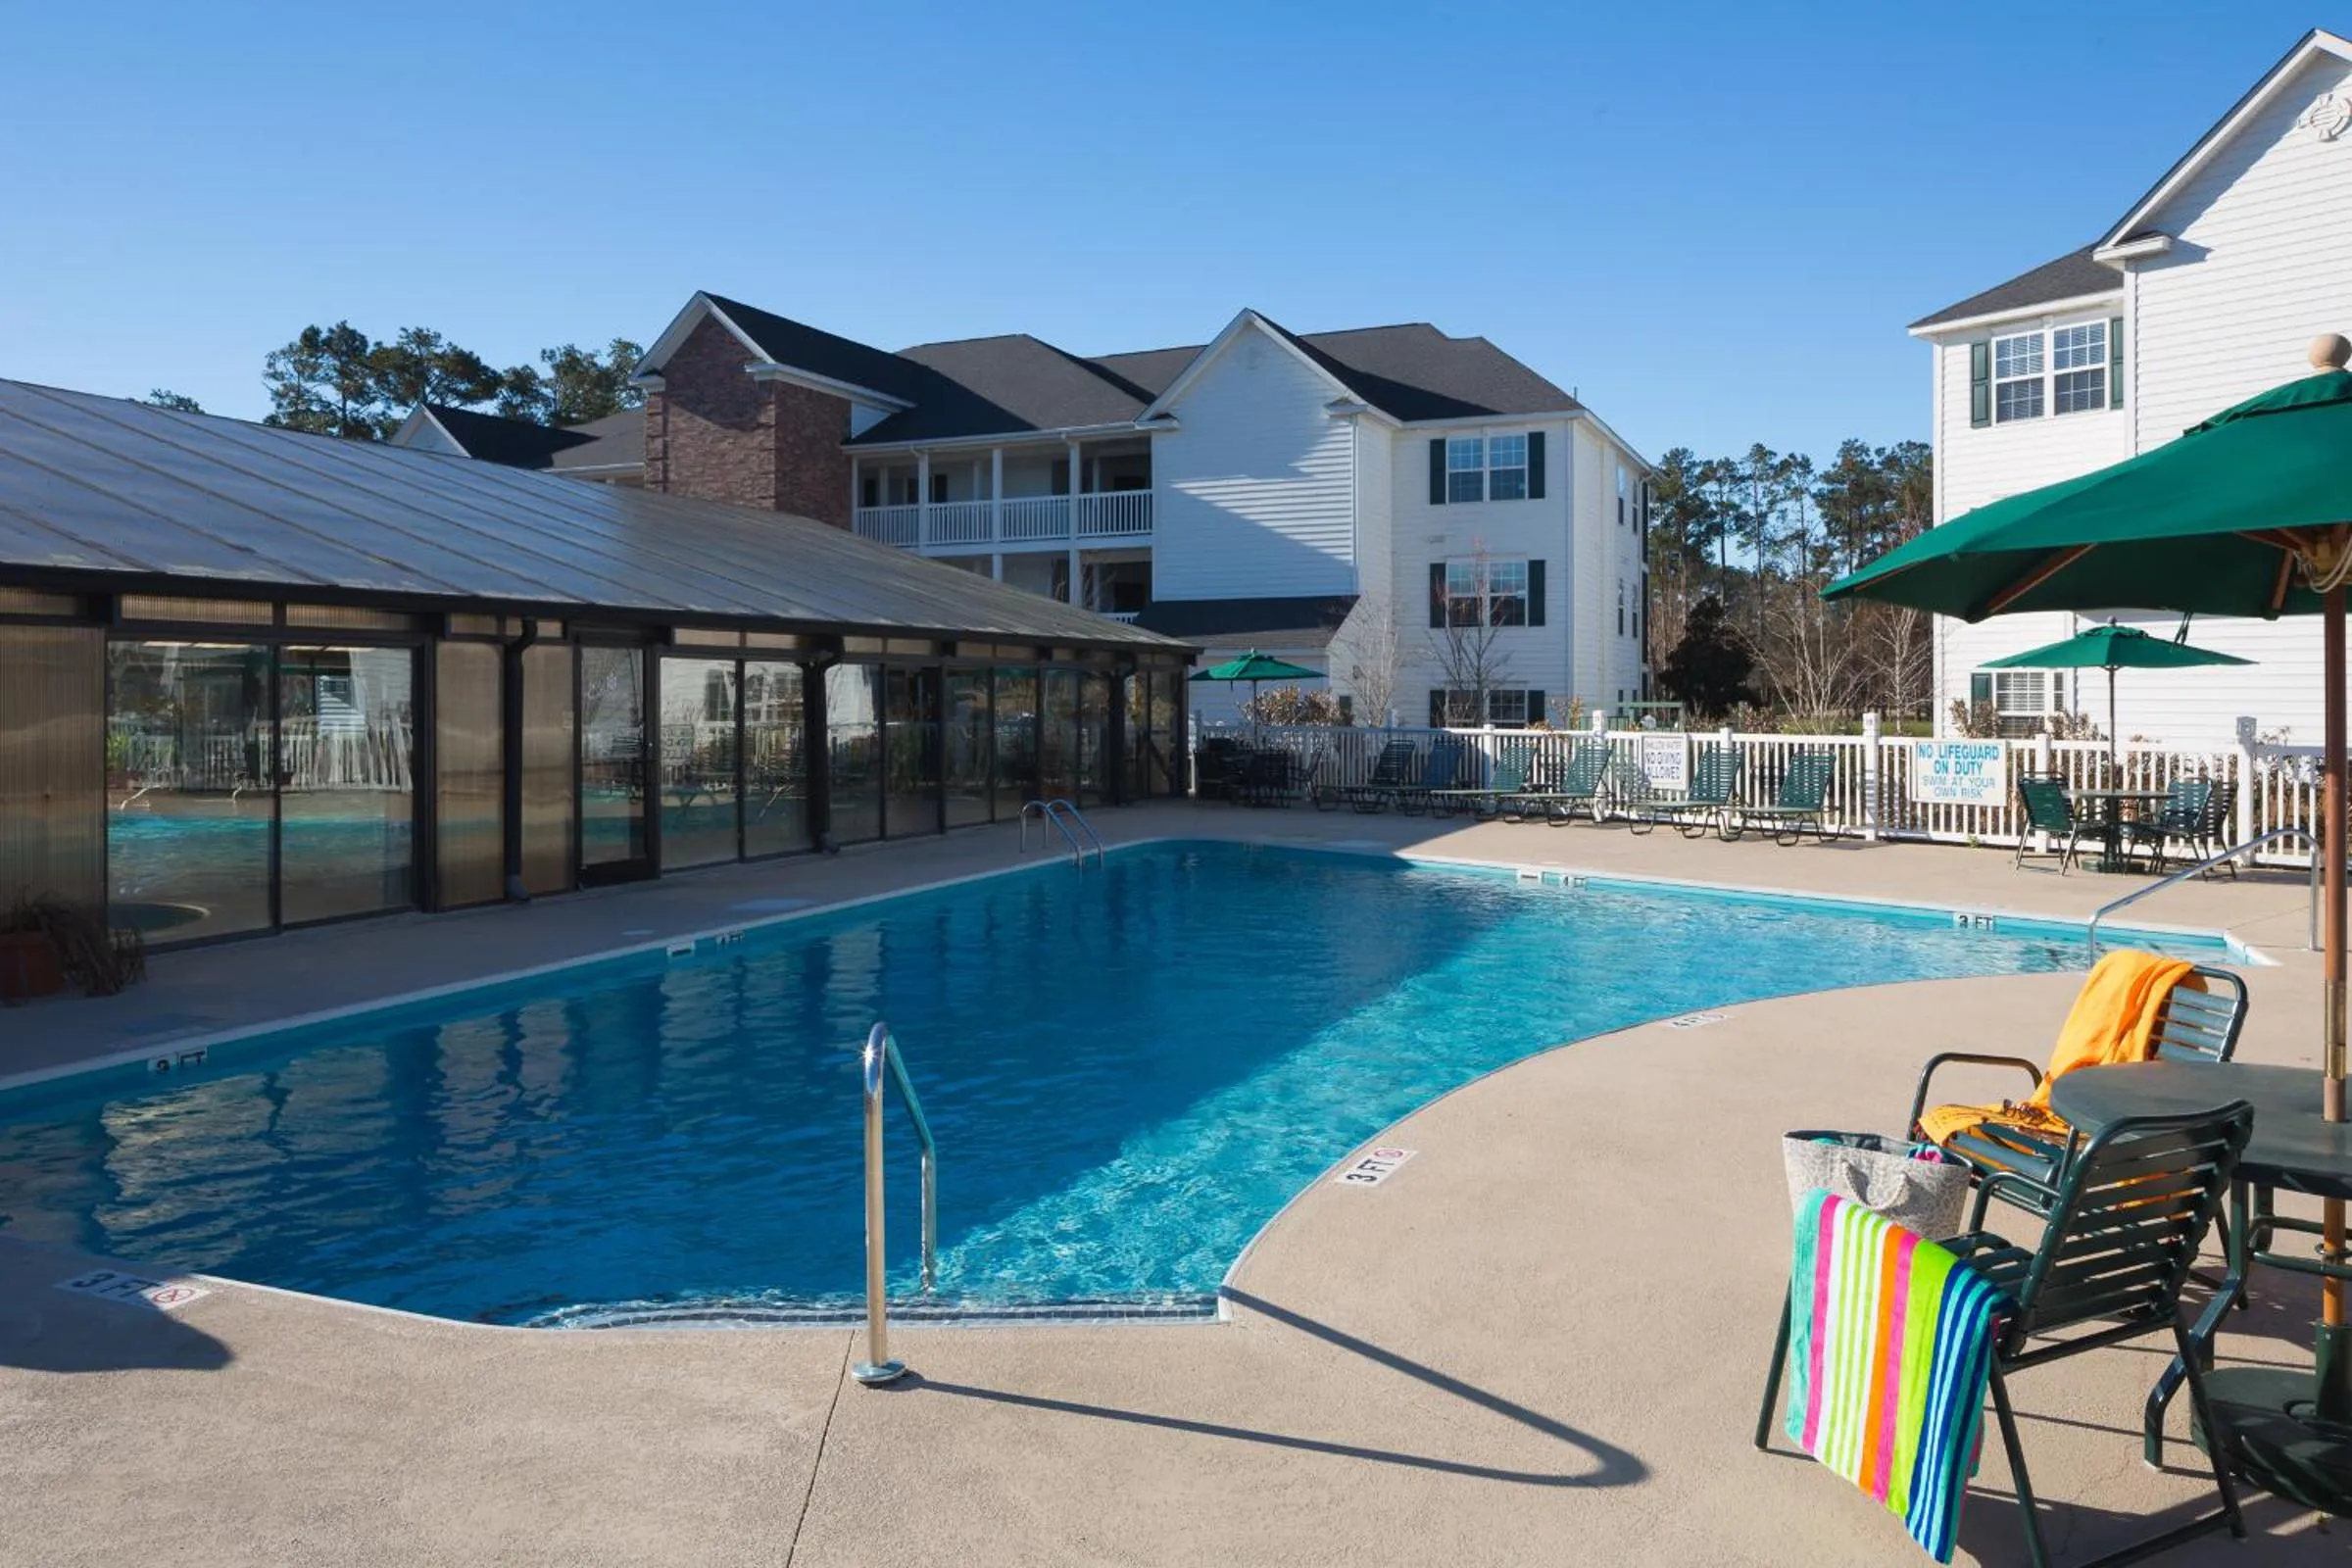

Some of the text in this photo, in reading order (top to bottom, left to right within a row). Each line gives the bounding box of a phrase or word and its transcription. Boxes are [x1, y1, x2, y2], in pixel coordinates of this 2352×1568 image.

[1646, 752, 1682, 765] NO DIVING
[1919, 745, 1999, 760] NO LIFEGUARD
[1646, 766, 1681, 780] ALLOWED
[1935, 760, 1983, 775] ON DUTY
[1922, 776, 1995, 788] SWIM AT YOUR
[1935, 787, 1984, 799] OWN RISK
[1975, 916, 1992, 930] FT
[99, 1278, 162, 1299] FT
